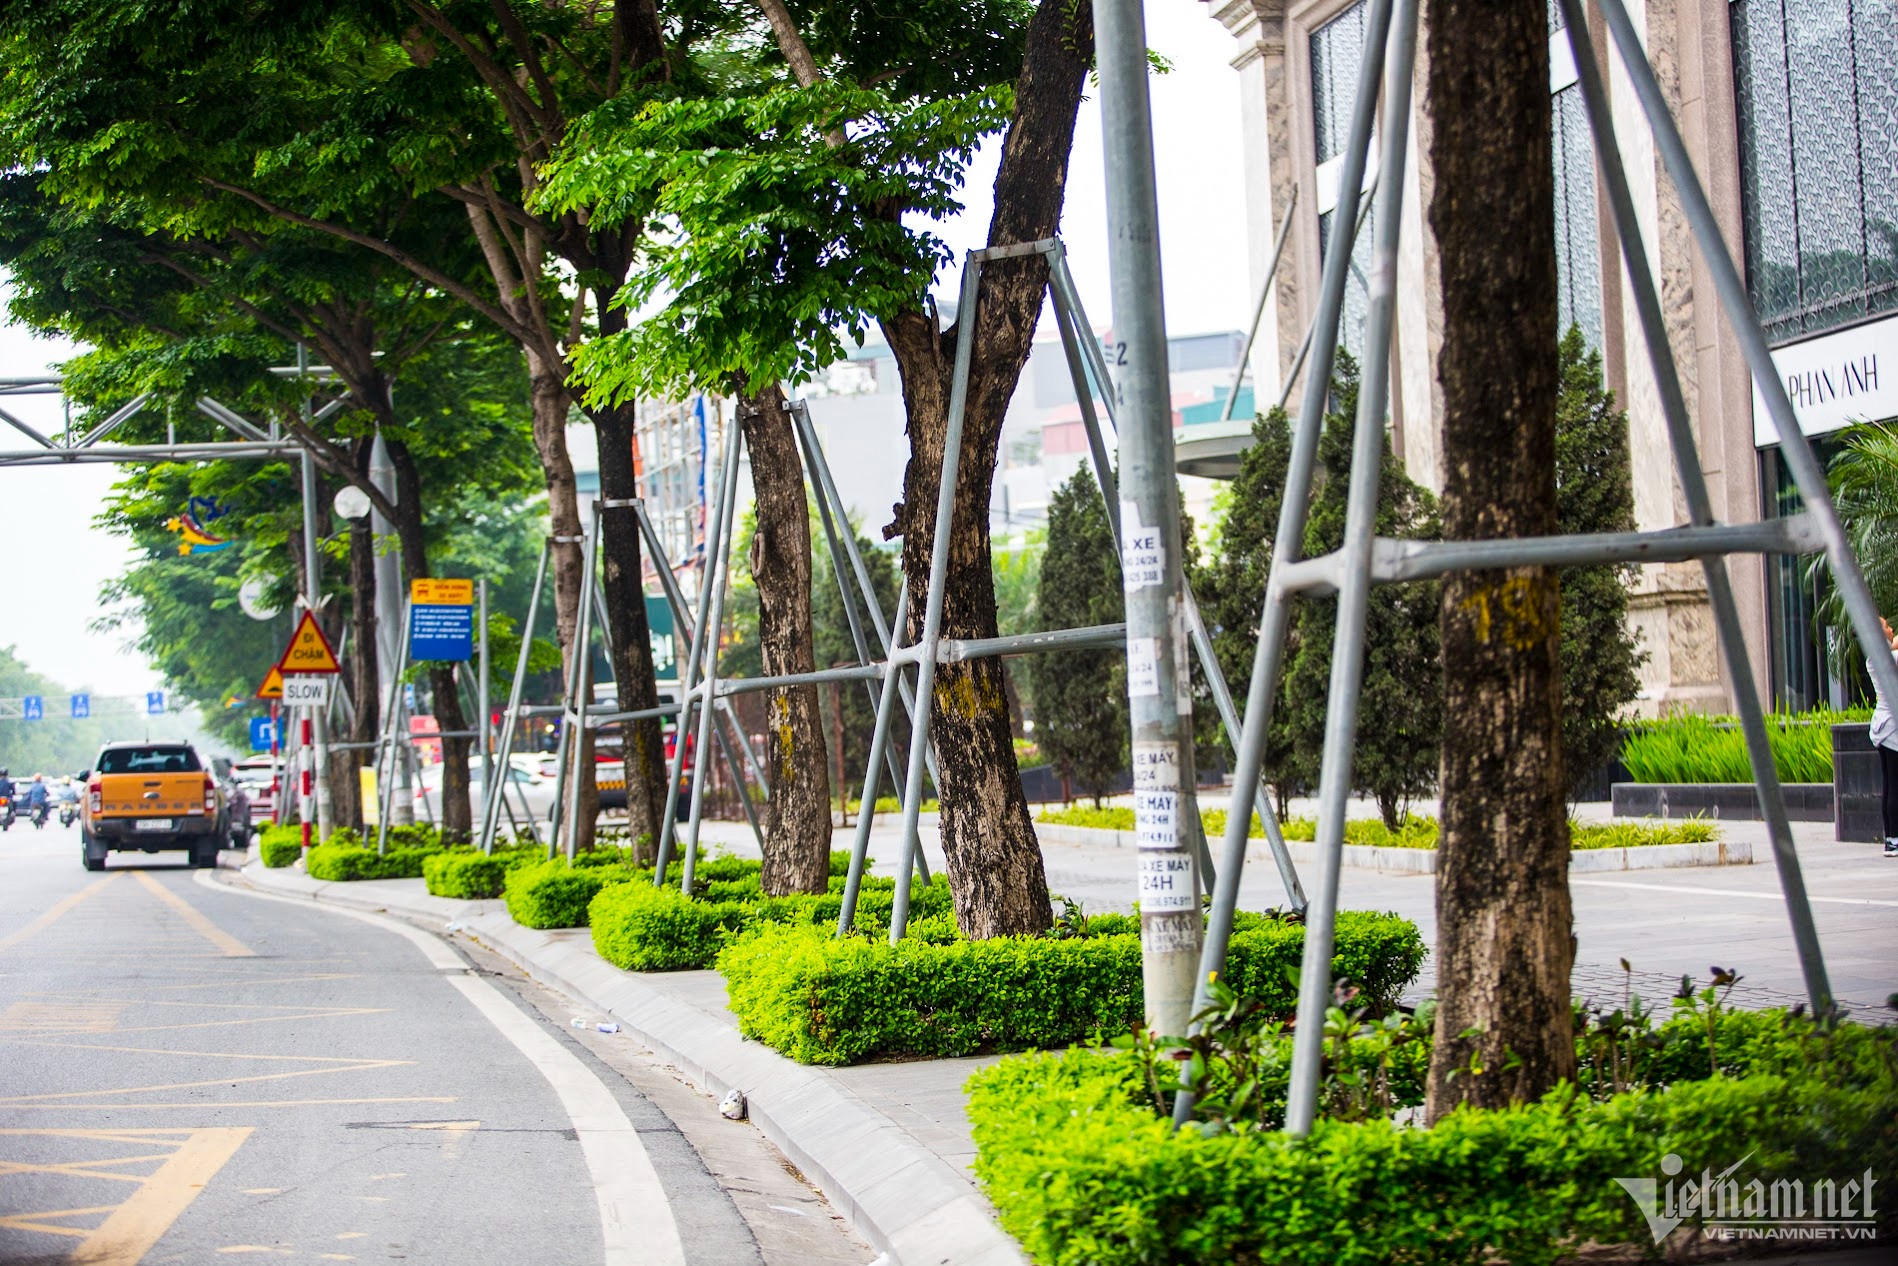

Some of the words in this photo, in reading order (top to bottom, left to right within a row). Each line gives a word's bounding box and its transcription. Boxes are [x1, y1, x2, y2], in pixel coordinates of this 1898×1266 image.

[1788, 365, 1836, 408] PHAN
[1841, 353, 1878, 398] ANH
[1133, 536, 1155, 551] XE
[287, 685, 323, 699] SLOW
[1143, 875, 1173, 891] 24H
